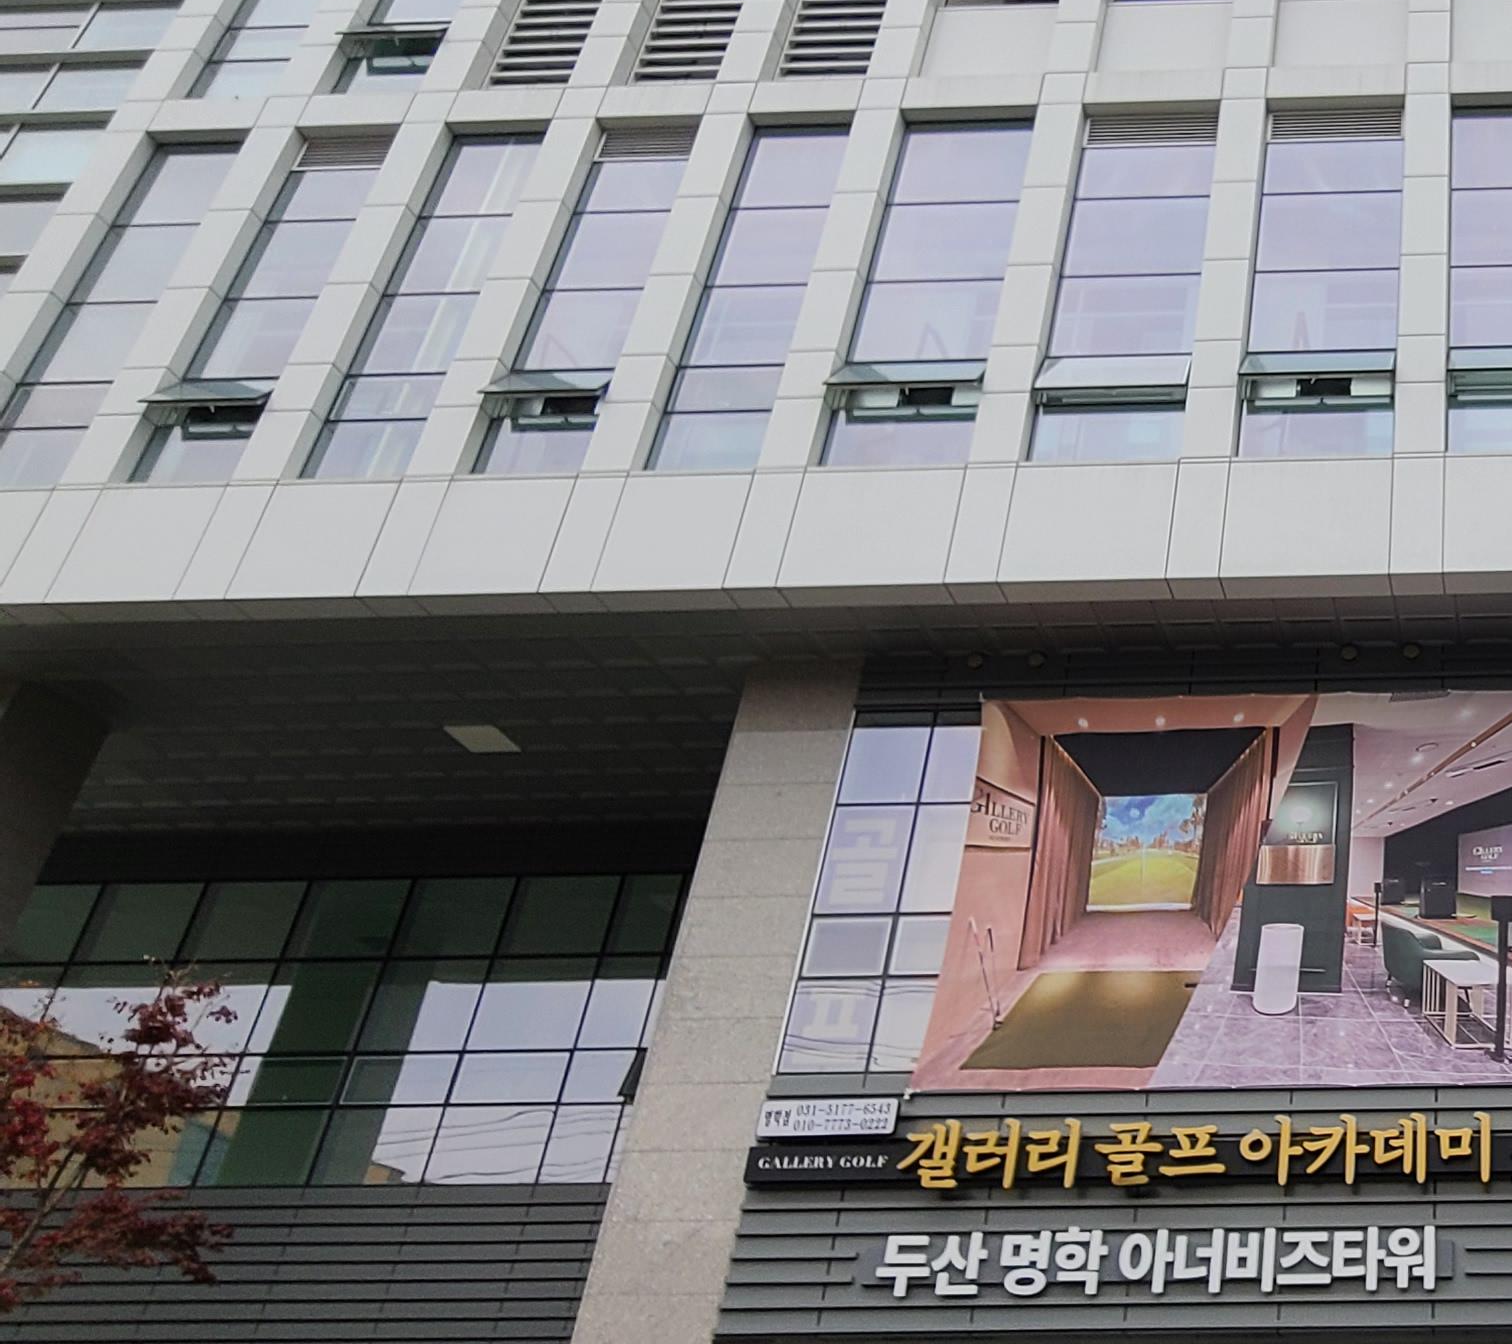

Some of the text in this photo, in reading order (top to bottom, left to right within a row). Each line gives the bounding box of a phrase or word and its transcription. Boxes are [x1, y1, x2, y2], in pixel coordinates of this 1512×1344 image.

[758, 1155, 888, 1169] GALLERY GOLF
[897, 1117, 1082, 1190] 갤러리
[1093, 1121, 1227, 1186] 골프
[1239, 1112, 1493, 1186] 아카데미
[875, 1224, 1437, 1297] 두산 명학 아너비즈타워
